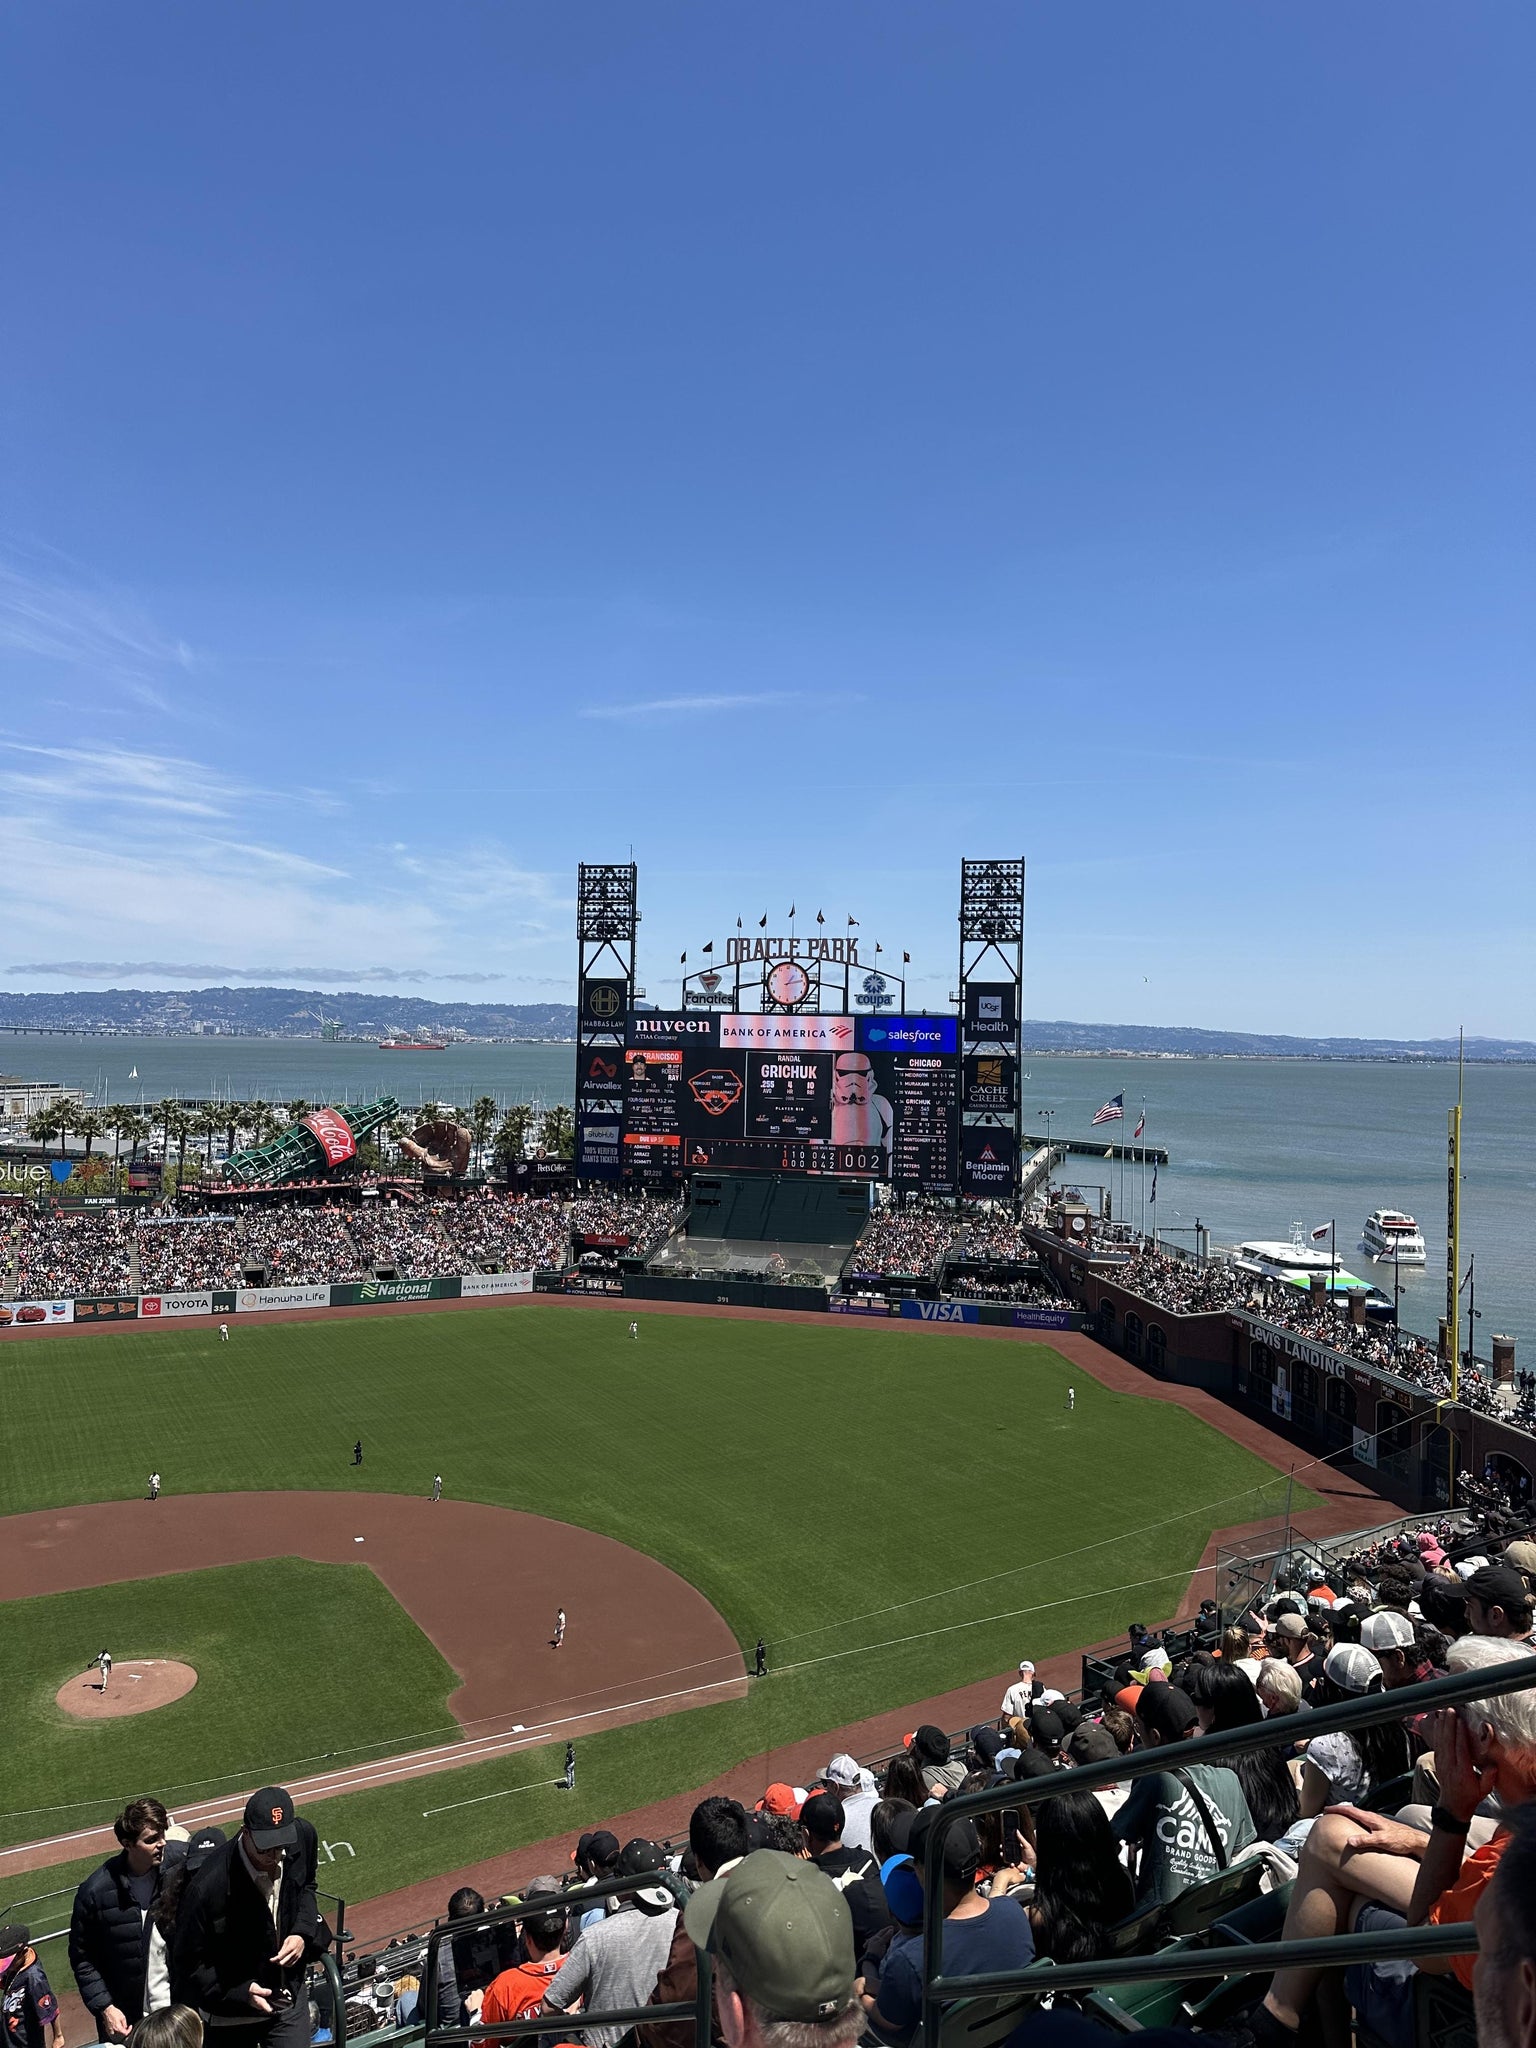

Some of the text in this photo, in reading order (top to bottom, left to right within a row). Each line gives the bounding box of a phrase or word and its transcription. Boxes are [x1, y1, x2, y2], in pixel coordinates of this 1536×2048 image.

[726, 937, 859, 966] ORACLE PARK
[685, 992, 734, 1004] Fanatics
[858, 995, 891, 1007] coupa
[981, 1002, 999, 1012] UCSF
[584, 1020, 610, 1028] HABBAS
[635, 1019, 711, 1033] nuveen
[971, 1021, 1009, 1033] Health
[723, 1028, 826, 1039] BANK OF AMERICA
[888, 1029, 941, 1043] salesforce
[644, 1052, 679, 1061] FRANCISCO
[909, 1059, 942, 1068] CHICAGO
[761, 1064, 817, 1079] GRICHUK
[583, 1081, 622, 1090] Airwallex
[760, 1080, 775, 1088] .255
[807, 1081, 815, 1089] 10
[969, 1086, 1009, 1094] CACHE
[970, 1094, 1007, 1103] CREEK
[588, 1130, 614, 1138] StubHub
[598, 1147, 618, 1156] VERIFIED
[800, 1151, 805, 1159] 0
[582, 1155, 619, 1164] GIANTS TICKETS
[782, 1159, 787, 1167] 0
[791, 1160, 796, 1168] 0
[800, 1160, 805, 1168] 0
[812, 1160, 817, 1168] 0
[829, 1161, 835, 1169] 2
[845, 1154, 879, 1169] 0 0 2
[551, 1164, 566, 1173] Coffee
[966, 1161, 1010, 1172] Benjamin
[972, 1171, 1004, 1180] Moore
[378, 1282, 432, 1296] National
[259, 1292, 325, 1304] Hanwha Life
[165, 1299, 209, 1310] TOYOTA
[915, 1302, 964, 1322] VISA
[1017, 1311, 1066, 1324] HealthEquity
[1081, 1323, 1094, 1331] 415
[1285, 1339, 1346, 1380] LANDING
[271, 1807, 283, 1825] SF
[1165, 1845, 1217, 1864] BRAND GOODS
